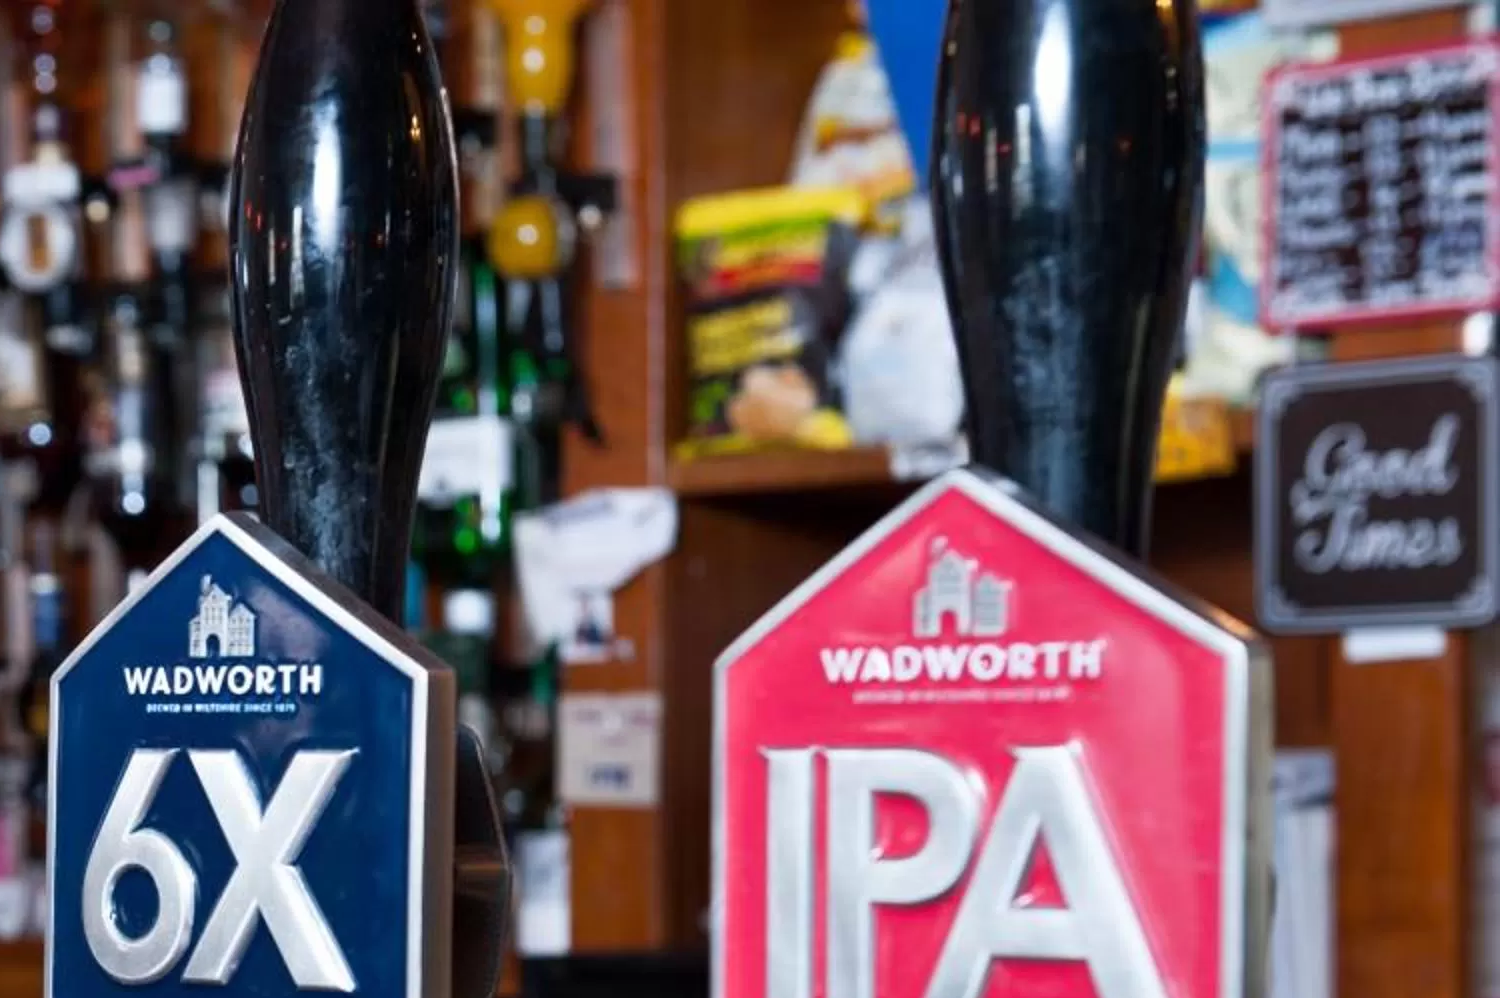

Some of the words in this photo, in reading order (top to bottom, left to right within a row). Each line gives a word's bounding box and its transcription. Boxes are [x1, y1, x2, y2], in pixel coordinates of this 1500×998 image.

[1303, 411, 1462, 503] Good
[1290, 482, 1463, 576] Times
[123, 664, 323, 695] WADWORTH
[820, 640, 1108, 684] WADWORTH
[81, 747, 360, 993] 6X
